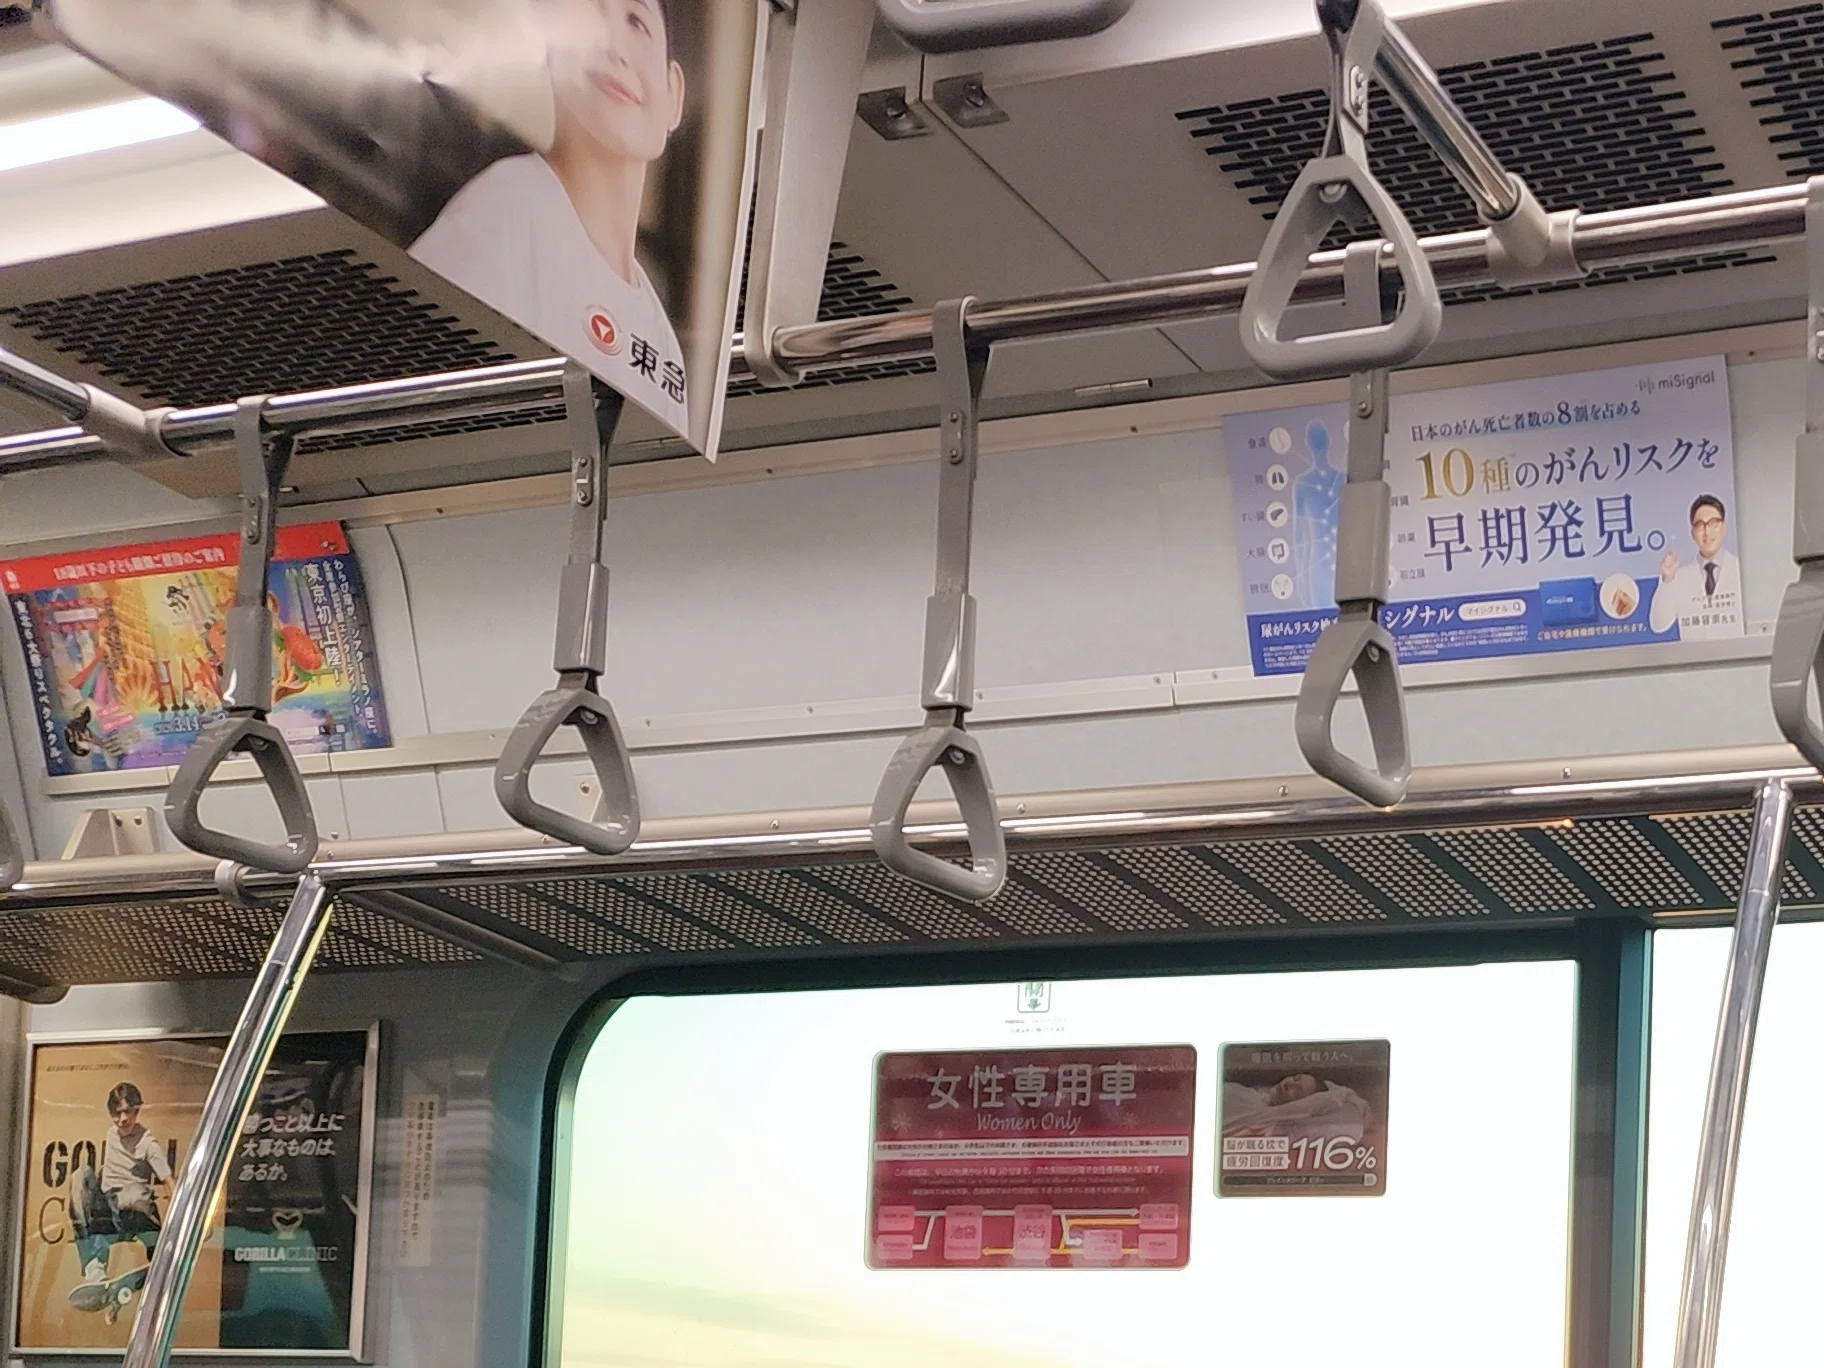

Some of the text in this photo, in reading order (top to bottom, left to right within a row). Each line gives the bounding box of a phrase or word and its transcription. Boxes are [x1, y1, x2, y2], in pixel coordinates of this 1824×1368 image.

[628, 332, 686, 405] 東急
[1658, 370, 1716, 391] miSignal
[1411, 399, 1642, 442] 日本のがん死亡者数の8割を占める
[1415, 436, 1720, 500] 10種のがんリスクを
[1423, 493, 1667, 571] 早期発見。
[1260, 616, 1338, 638] 尿がんリスク検
[926, 1061, 1138, 1110] 女性専用車
[976, 1110, 1083, 1136] Women Only
[1226, 1139, 1287, 1151] 脳が眠る枕で
[238, 1163, 289, 1182] あるか。
[1226, 1156, 1285, 1168] 疲労回復度
